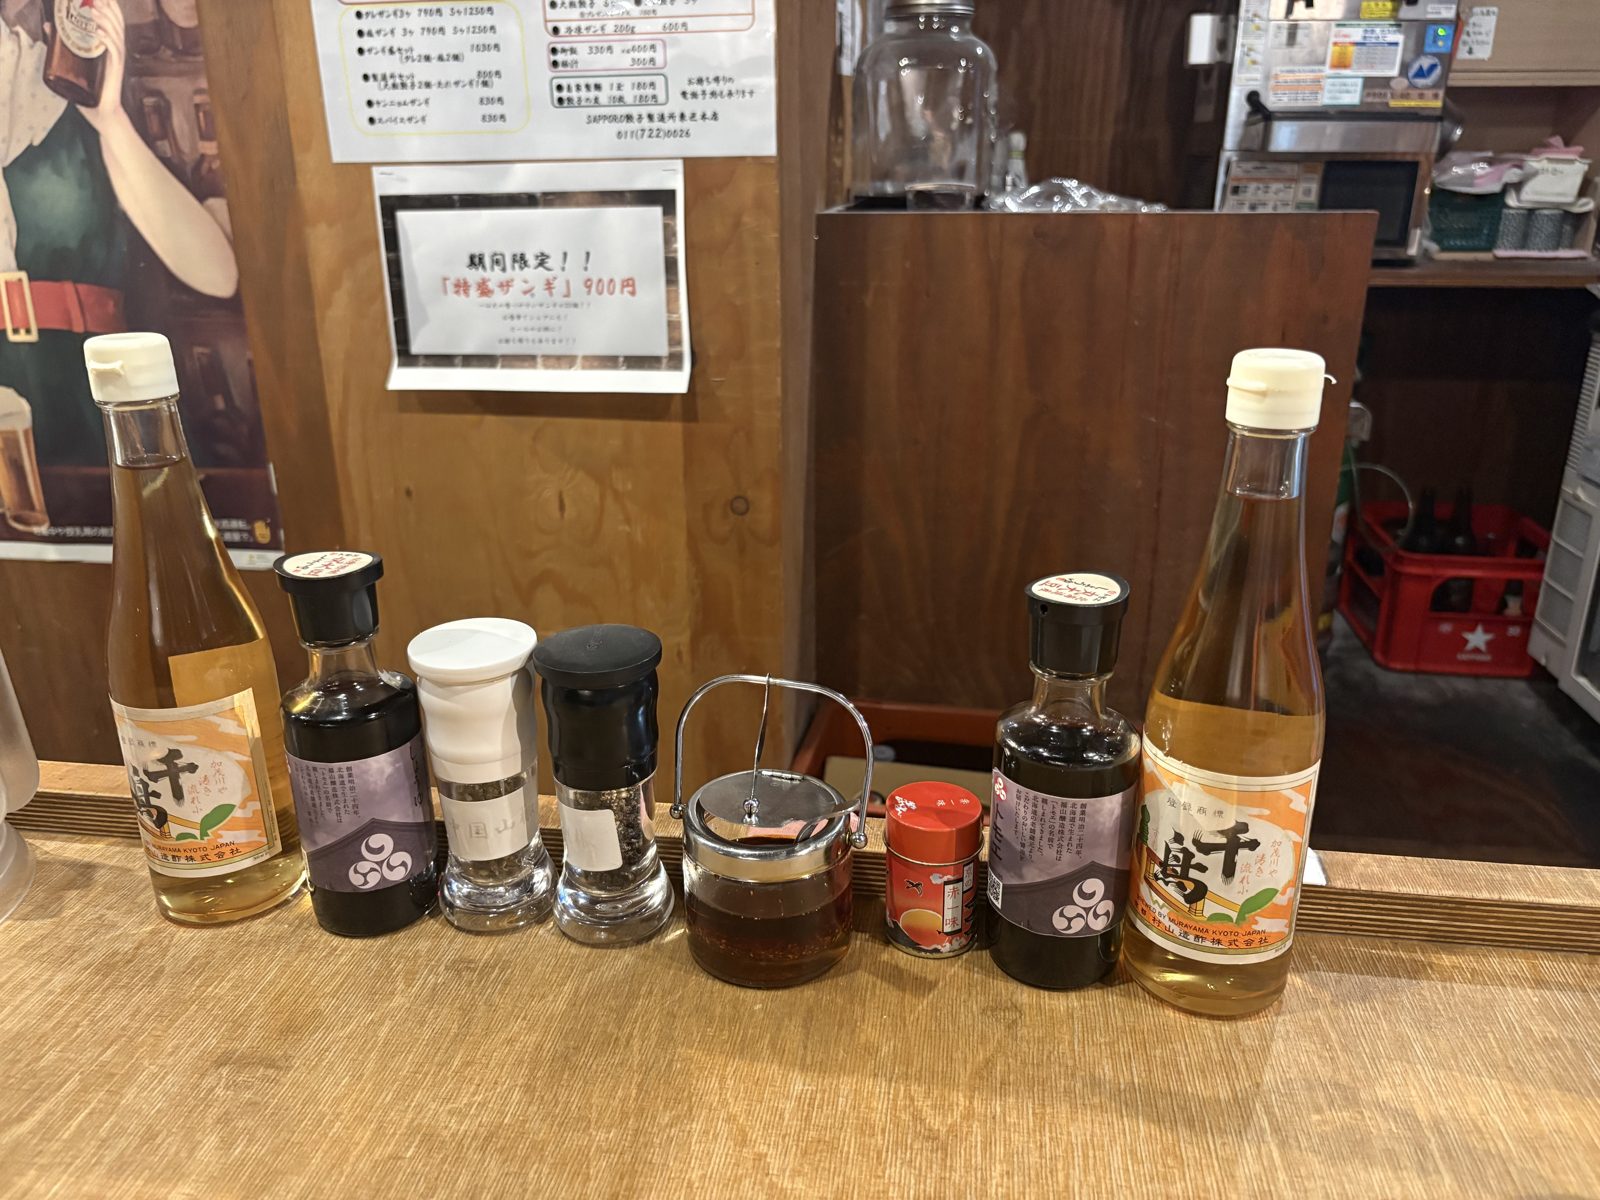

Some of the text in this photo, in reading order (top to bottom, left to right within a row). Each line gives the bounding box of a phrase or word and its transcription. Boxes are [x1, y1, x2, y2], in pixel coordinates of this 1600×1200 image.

[613, 24, 636, 34] 200g
[662, 22, 688, 32] 600円
[587, 45, 614, 55] 330円
[629, 57, 657, 67] 300円
[630, 81, 656, 91] 180円
[632, 94, 659, 104] 180円
[1166, 796, 1225, 819] 登録商標
[1056, 801, 1068, 862] 福山醸造株式会社は
[1066, 802, 1078, 855] 北海道で生まれた
[211, 840, 236, 851] JAPAN
[945, 885, 961, 929] 赤一味
[1152, 915, 1270, 948] 村山造酢株式会社
[1158, 912, 1167, 920] BY
[1168, 917, 1210, 934] MURAYAMA
[1212, 929, 1239, 937] KYOTO
[1241, 929, 1266, 937] JAPAN
